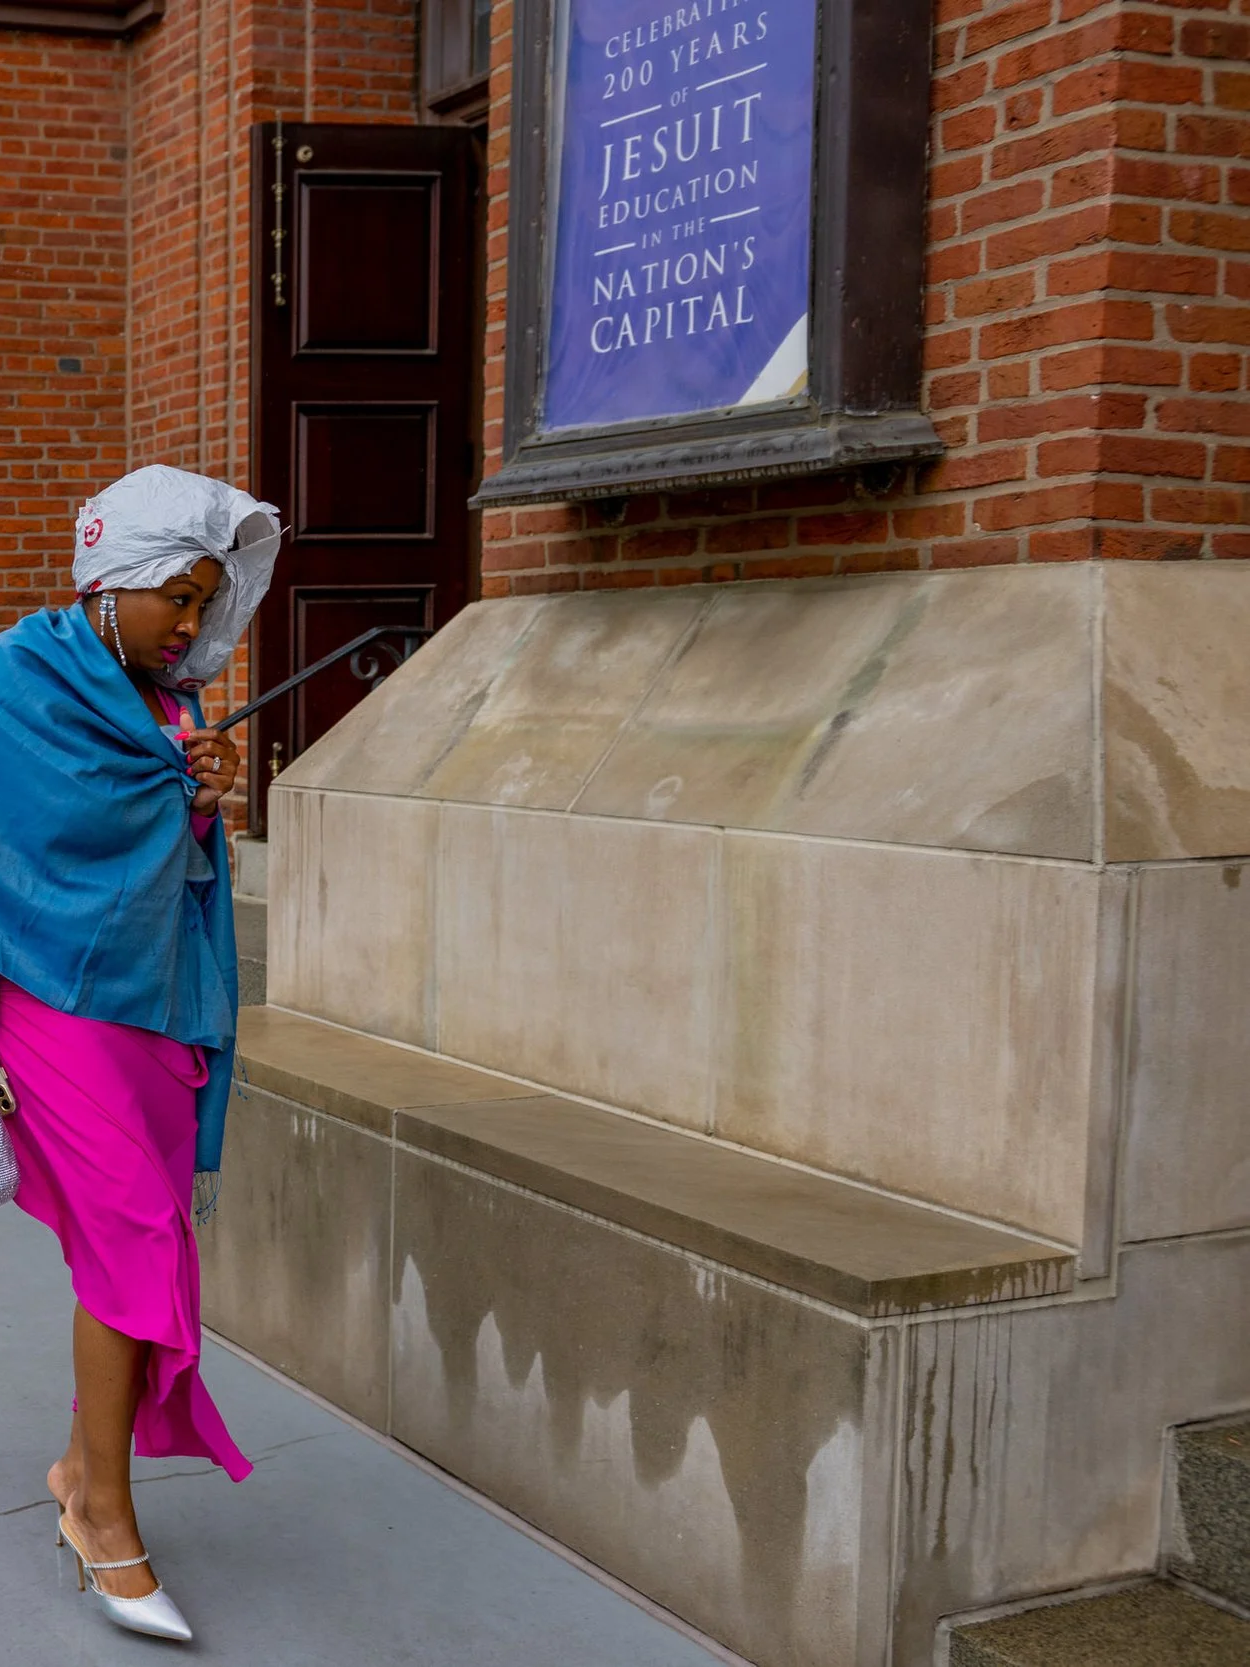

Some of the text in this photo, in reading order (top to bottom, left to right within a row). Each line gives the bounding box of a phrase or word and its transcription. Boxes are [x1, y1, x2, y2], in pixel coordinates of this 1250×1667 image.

[603, 11, 769, 100] 200 YEARS
[670, 87, 689, 108] OF
[599, 92, 762, 200] JESUIT
[598, 160, 759, 229] EDUCATION
[641, 216, 707, 249] IN THE
[593, 236, 756, 305] NATION'S
[590, 285, 754, 353] CAPITAL
